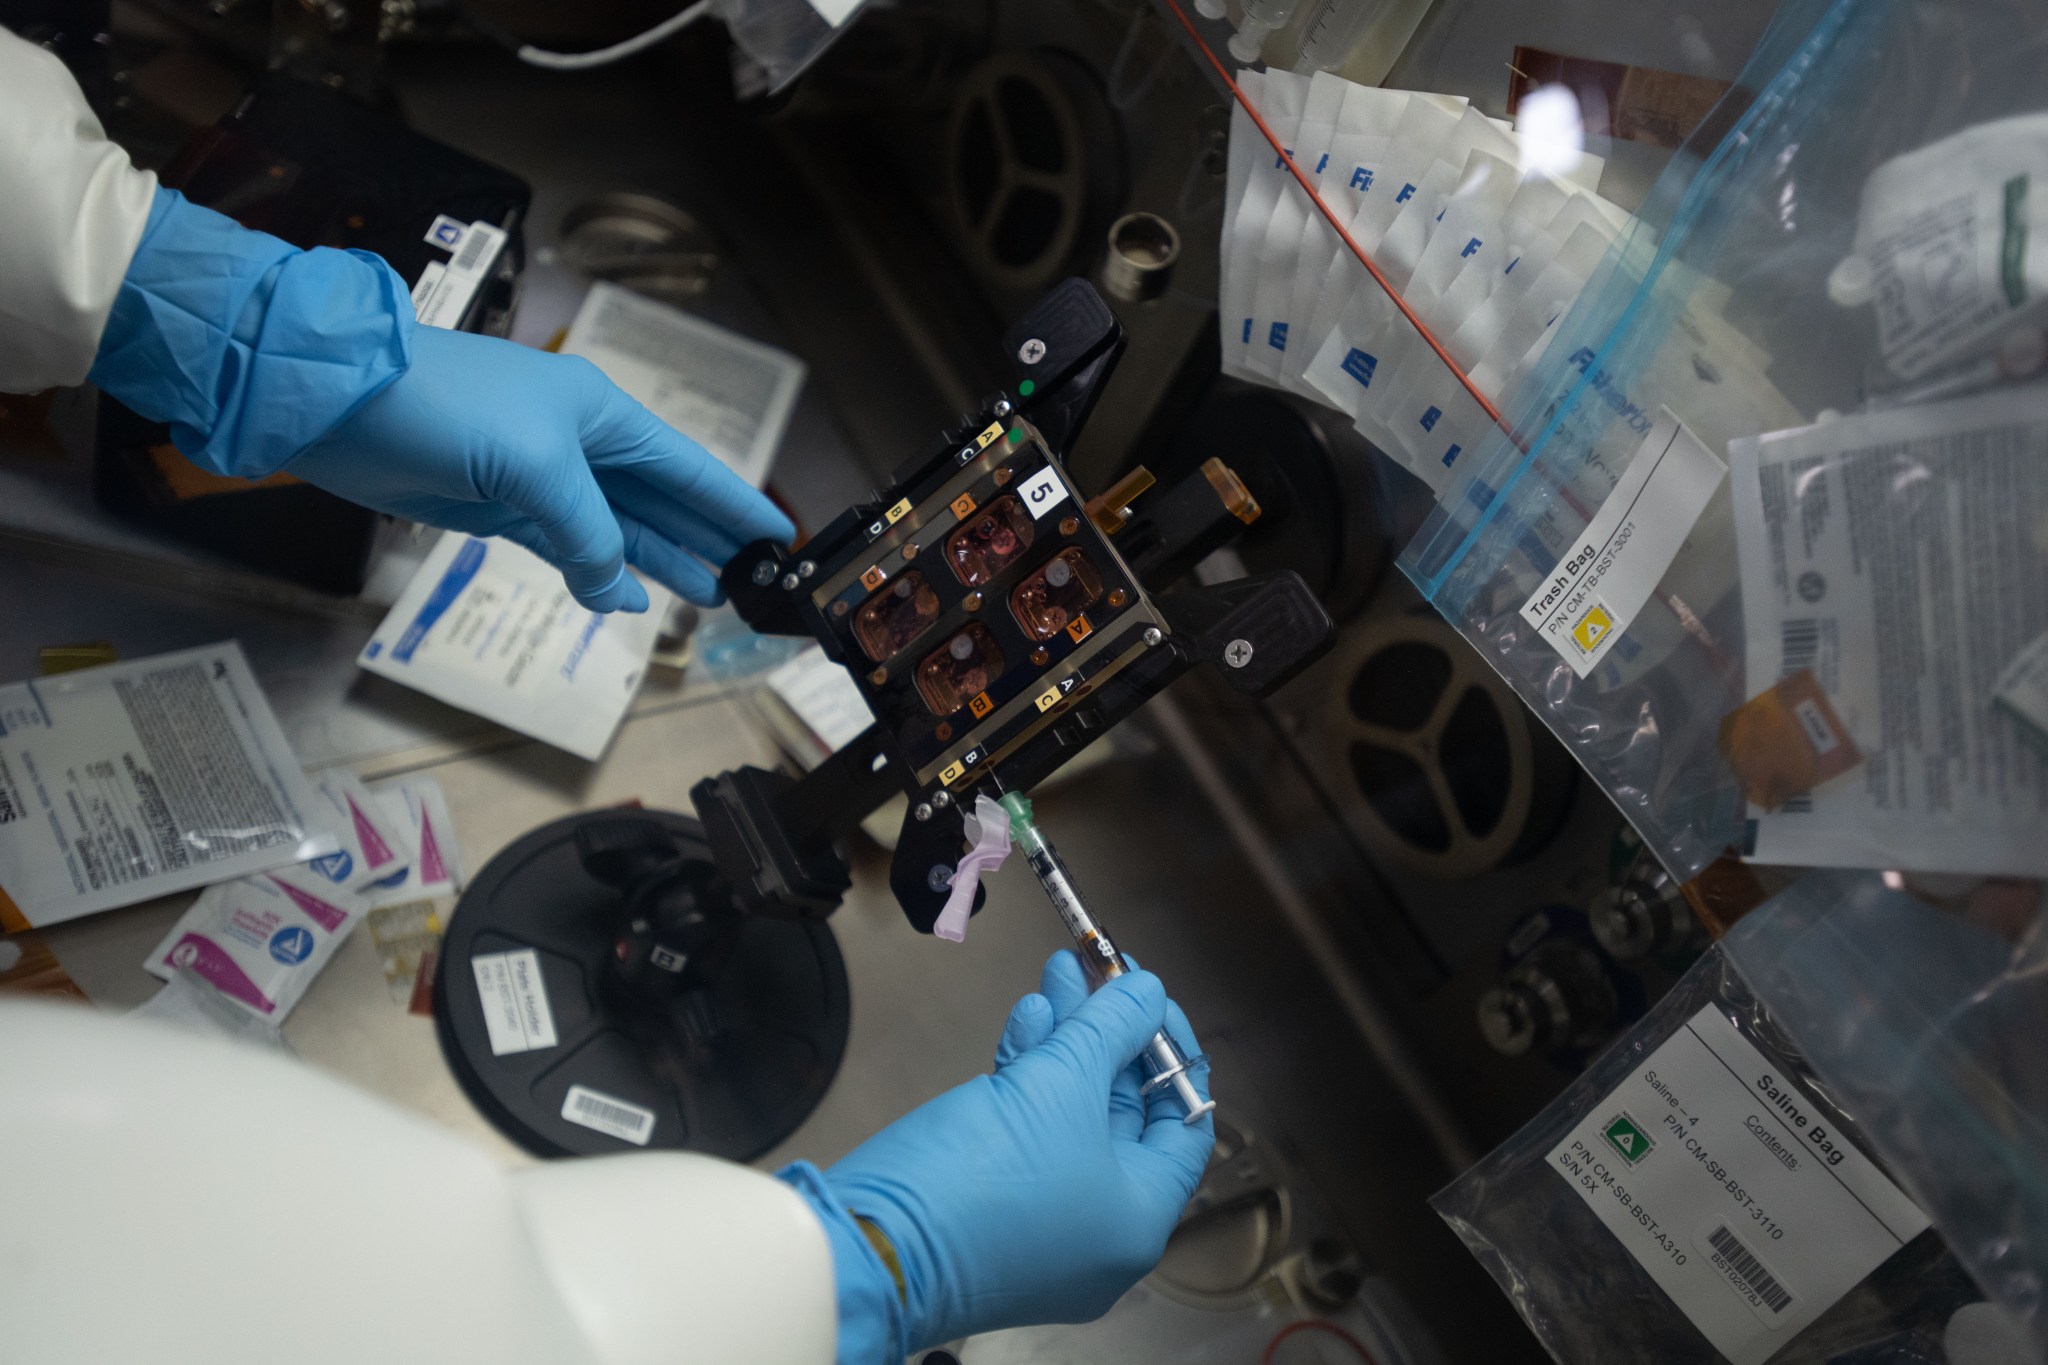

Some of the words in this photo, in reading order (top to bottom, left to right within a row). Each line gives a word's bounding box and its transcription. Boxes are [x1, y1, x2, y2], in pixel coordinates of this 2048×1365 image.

[981, 430, 994, 443] A
[961, 447, 974, 461] C
[1030, 482, 1054, 503] 5
[891, 506, 902, 518] B
[956, 500, 969, 514] C
[870, 521, 882, 534] D
[866, 570, 878, 584] D
[1530, 575, 1569, 617] Trash
[1565, 544, 1596, 576] Bag
[1070, 620, 1084, 634] A
[1548, 612, 1569, 635] P/N
[1590, 626, 1597, 634] 2
[1061, 678, 1074, 691] A
[973, 700, 986, 712] B
[1042, 695, 1054, 706] C
[966, 751, 978, 764] B
[944, 768, 956, 779] D
[1050, 882, 1059, 893] 2
[1060, 898, 1068, 908] 3
[1071, 914, 1079, 922] 4
[1645, 1071, 1678, 1107] Saline
[1688, 1118, 1699, 1126] 4
[1756, 1074, 1808, 1128] Saline
[1808, 1126, 1845, 1166] Bag
[1746, 1114, 1801, 1172] Contents:
[1559, 1153, 1582, 1176] S/N
[1581, 1175, 1600, 1194] 5X
[1664, 1114, 1688, 1140] P/N
[1686, 1138, 1783, 1240] CM-SB-BST-3110
[1570, 1140, 1594, 1164] P/N
[1593, 1164, 1687, 1266] CM-SB-BST-A310
[1710, 1252, 1763, 1307] BST02078J
